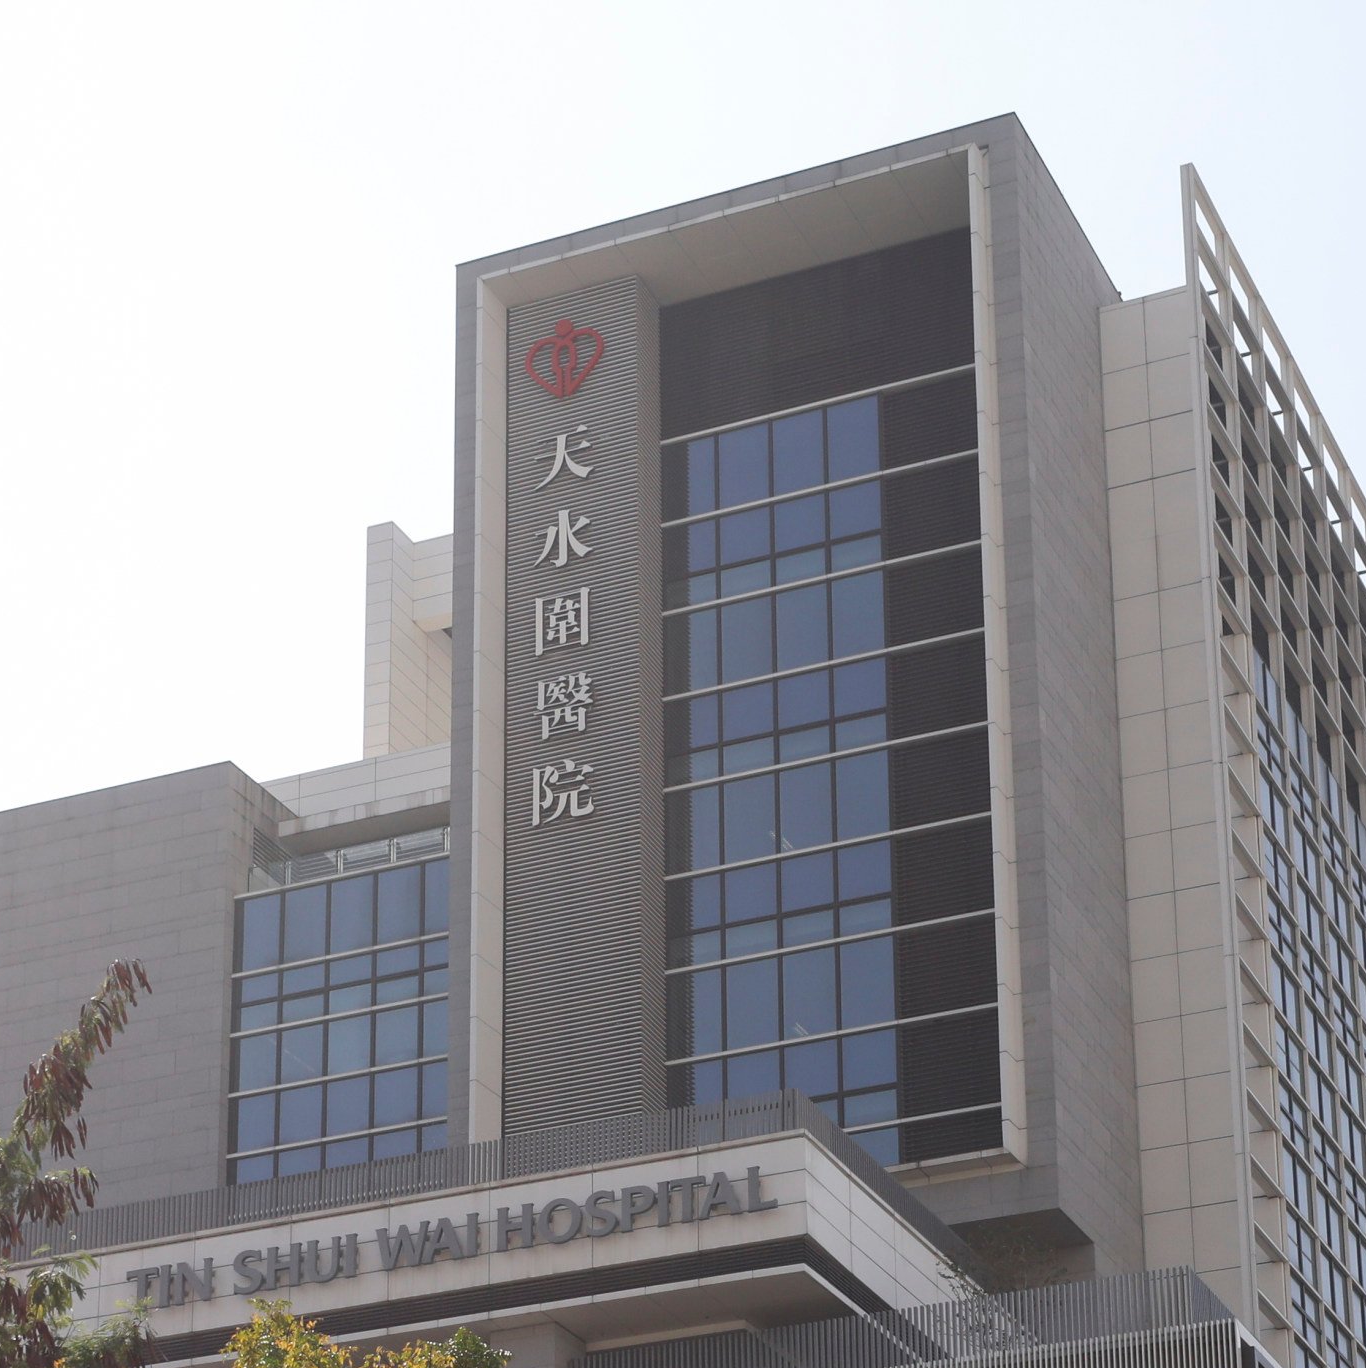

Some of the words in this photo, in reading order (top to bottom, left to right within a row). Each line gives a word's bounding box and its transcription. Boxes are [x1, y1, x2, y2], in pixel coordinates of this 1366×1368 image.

[531, 423, 595, 827] 天水圍醫院
[126, 1257, 215, 1309] TIN
[232, 1232, 358, 1297] SHUI
[376, 1210, 480, 1270] WAI
[495, 1164, 780, 1253] HOSPITAL
